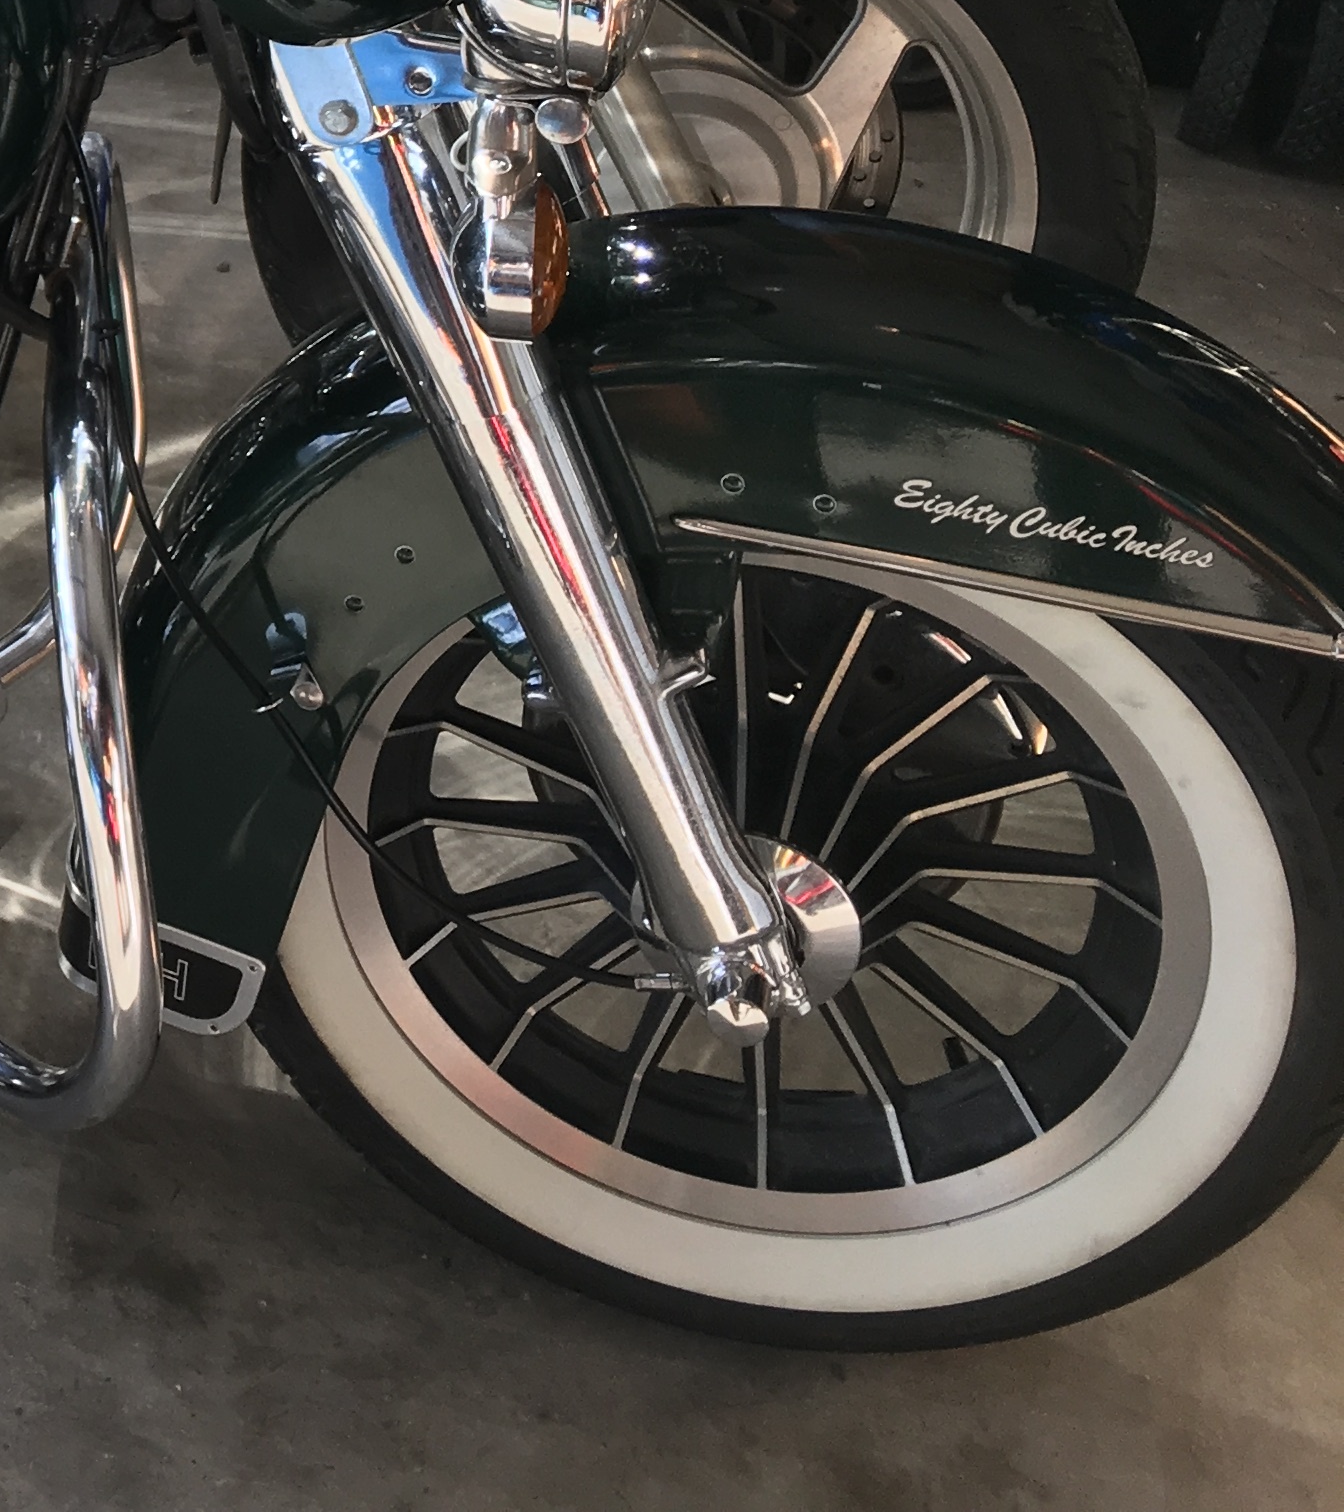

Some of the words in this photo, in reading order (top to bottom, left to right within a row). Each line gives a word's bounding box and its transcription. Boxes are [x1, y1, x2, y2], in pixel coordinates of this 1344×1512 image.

[893, 479, 1008, 533] Eighty
[1009, 507, 1106, 548] Cubic
[1111, 525, 1214, 568] Inches
